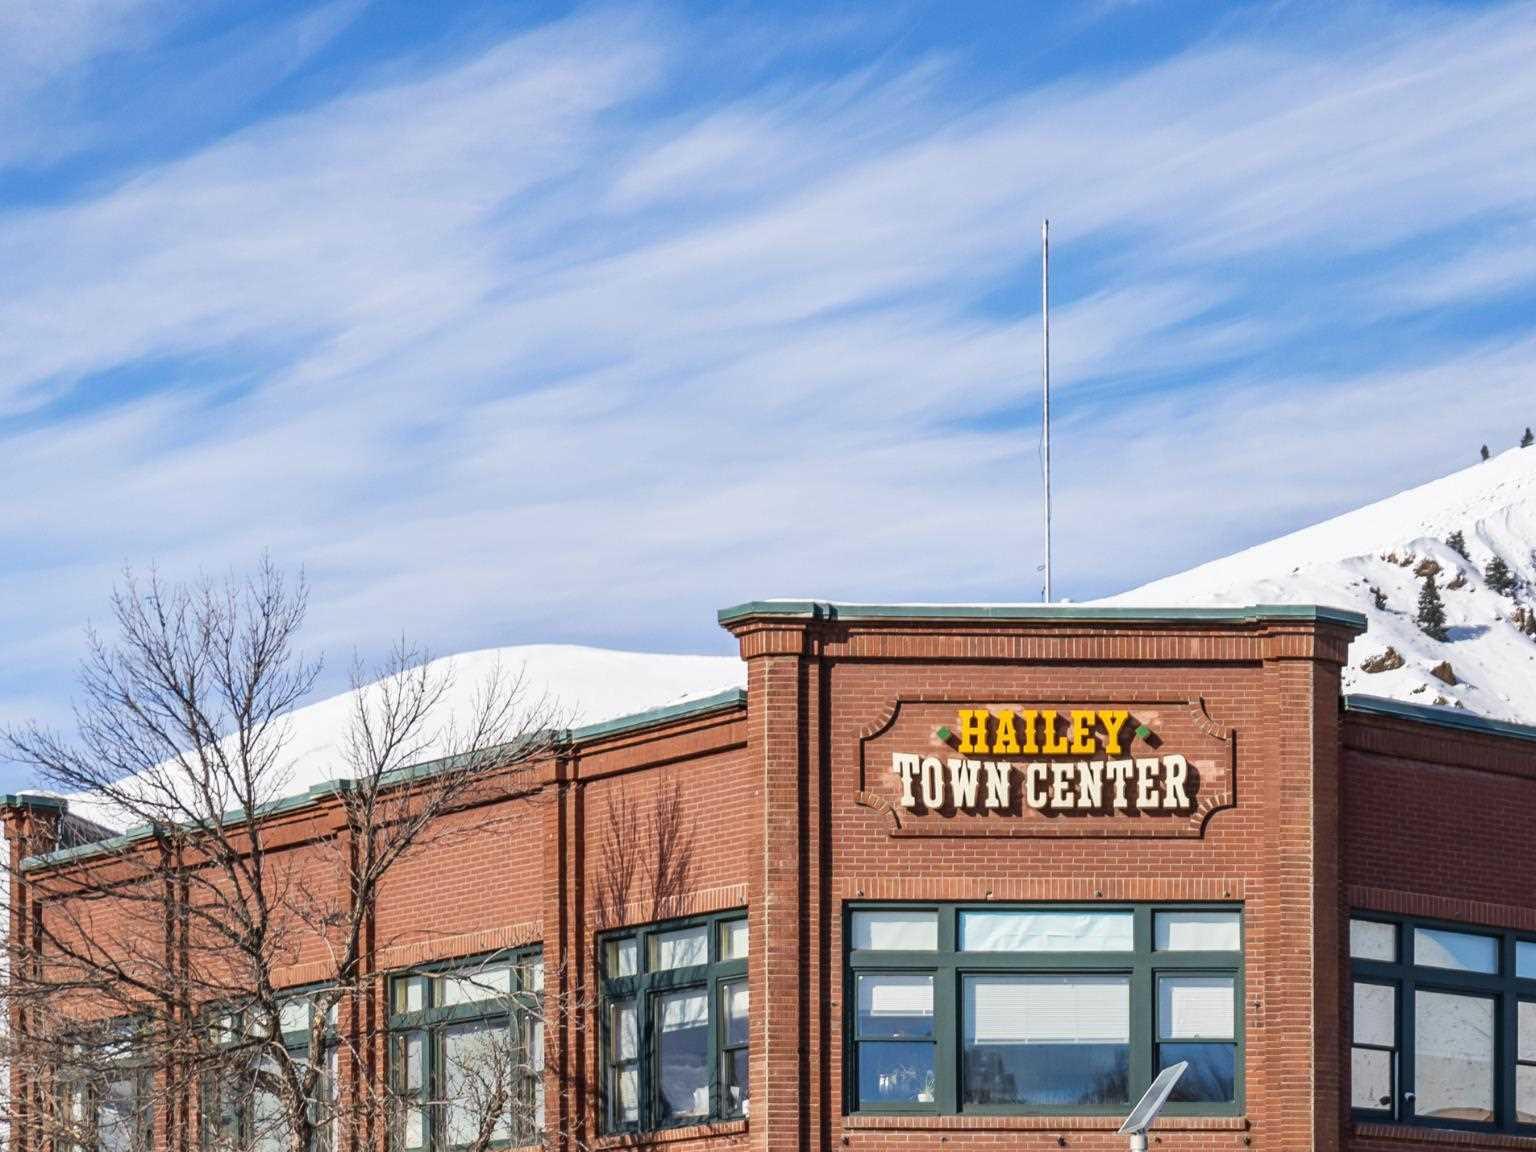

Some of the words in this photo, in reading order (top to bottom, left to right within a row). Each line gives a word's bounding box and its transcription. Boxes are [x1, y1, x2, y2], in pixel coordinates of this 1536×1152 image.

[958, 709, 1130, 755] HAILEY
[892, 752, 1014, 809] TOWN
[1025, 754, 1191, 810] CENTER
